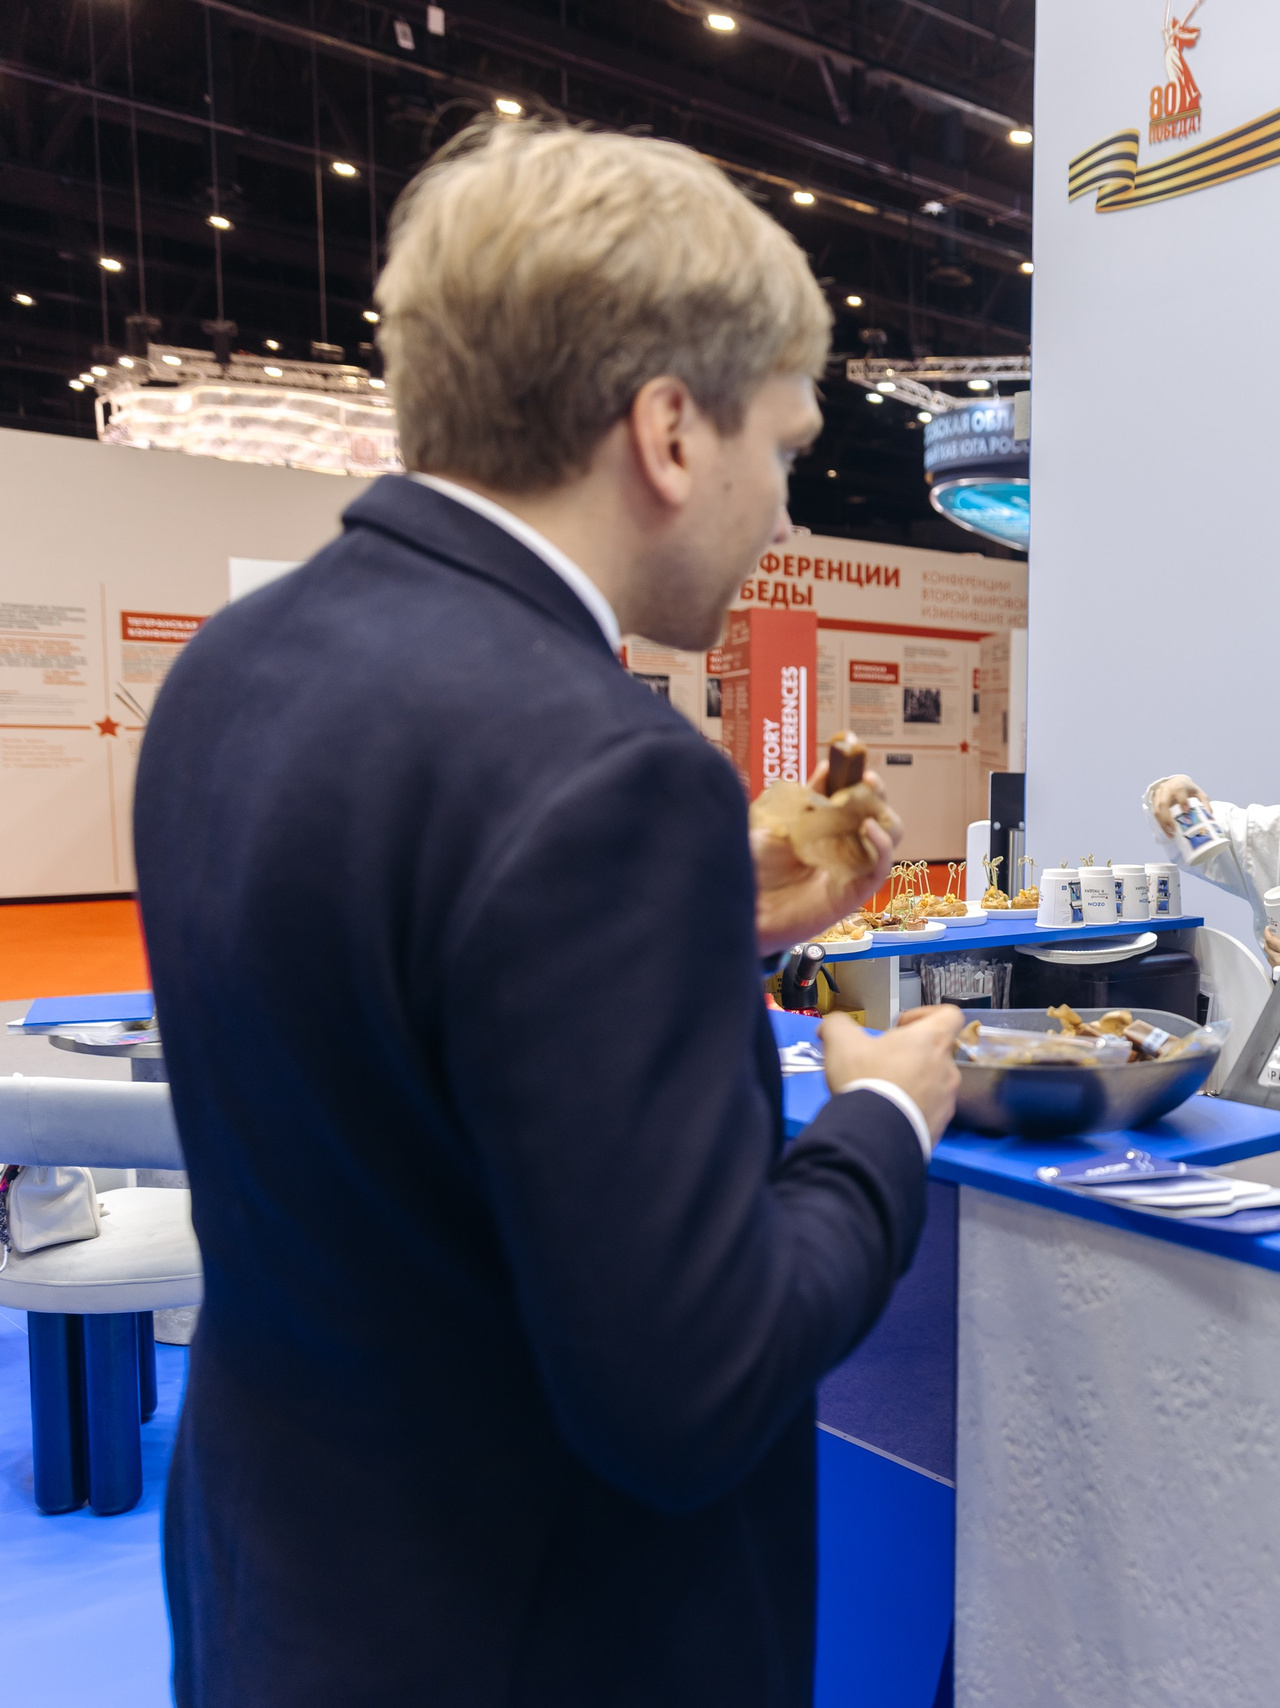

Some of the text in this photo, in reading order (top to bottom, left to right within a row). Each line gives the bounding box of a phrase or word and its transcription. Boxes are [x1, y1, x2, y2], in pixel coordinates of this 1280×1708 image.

[1149, 82, 1177, 121] 80
[759, 551, 901, 590] ФЕРЕНЦИИ
[740, 579, 814, 610] БЕДЫ
[972, 594, 1028, 612] МИРОВО
[781, 665, 799, 783] ONFERENCES
